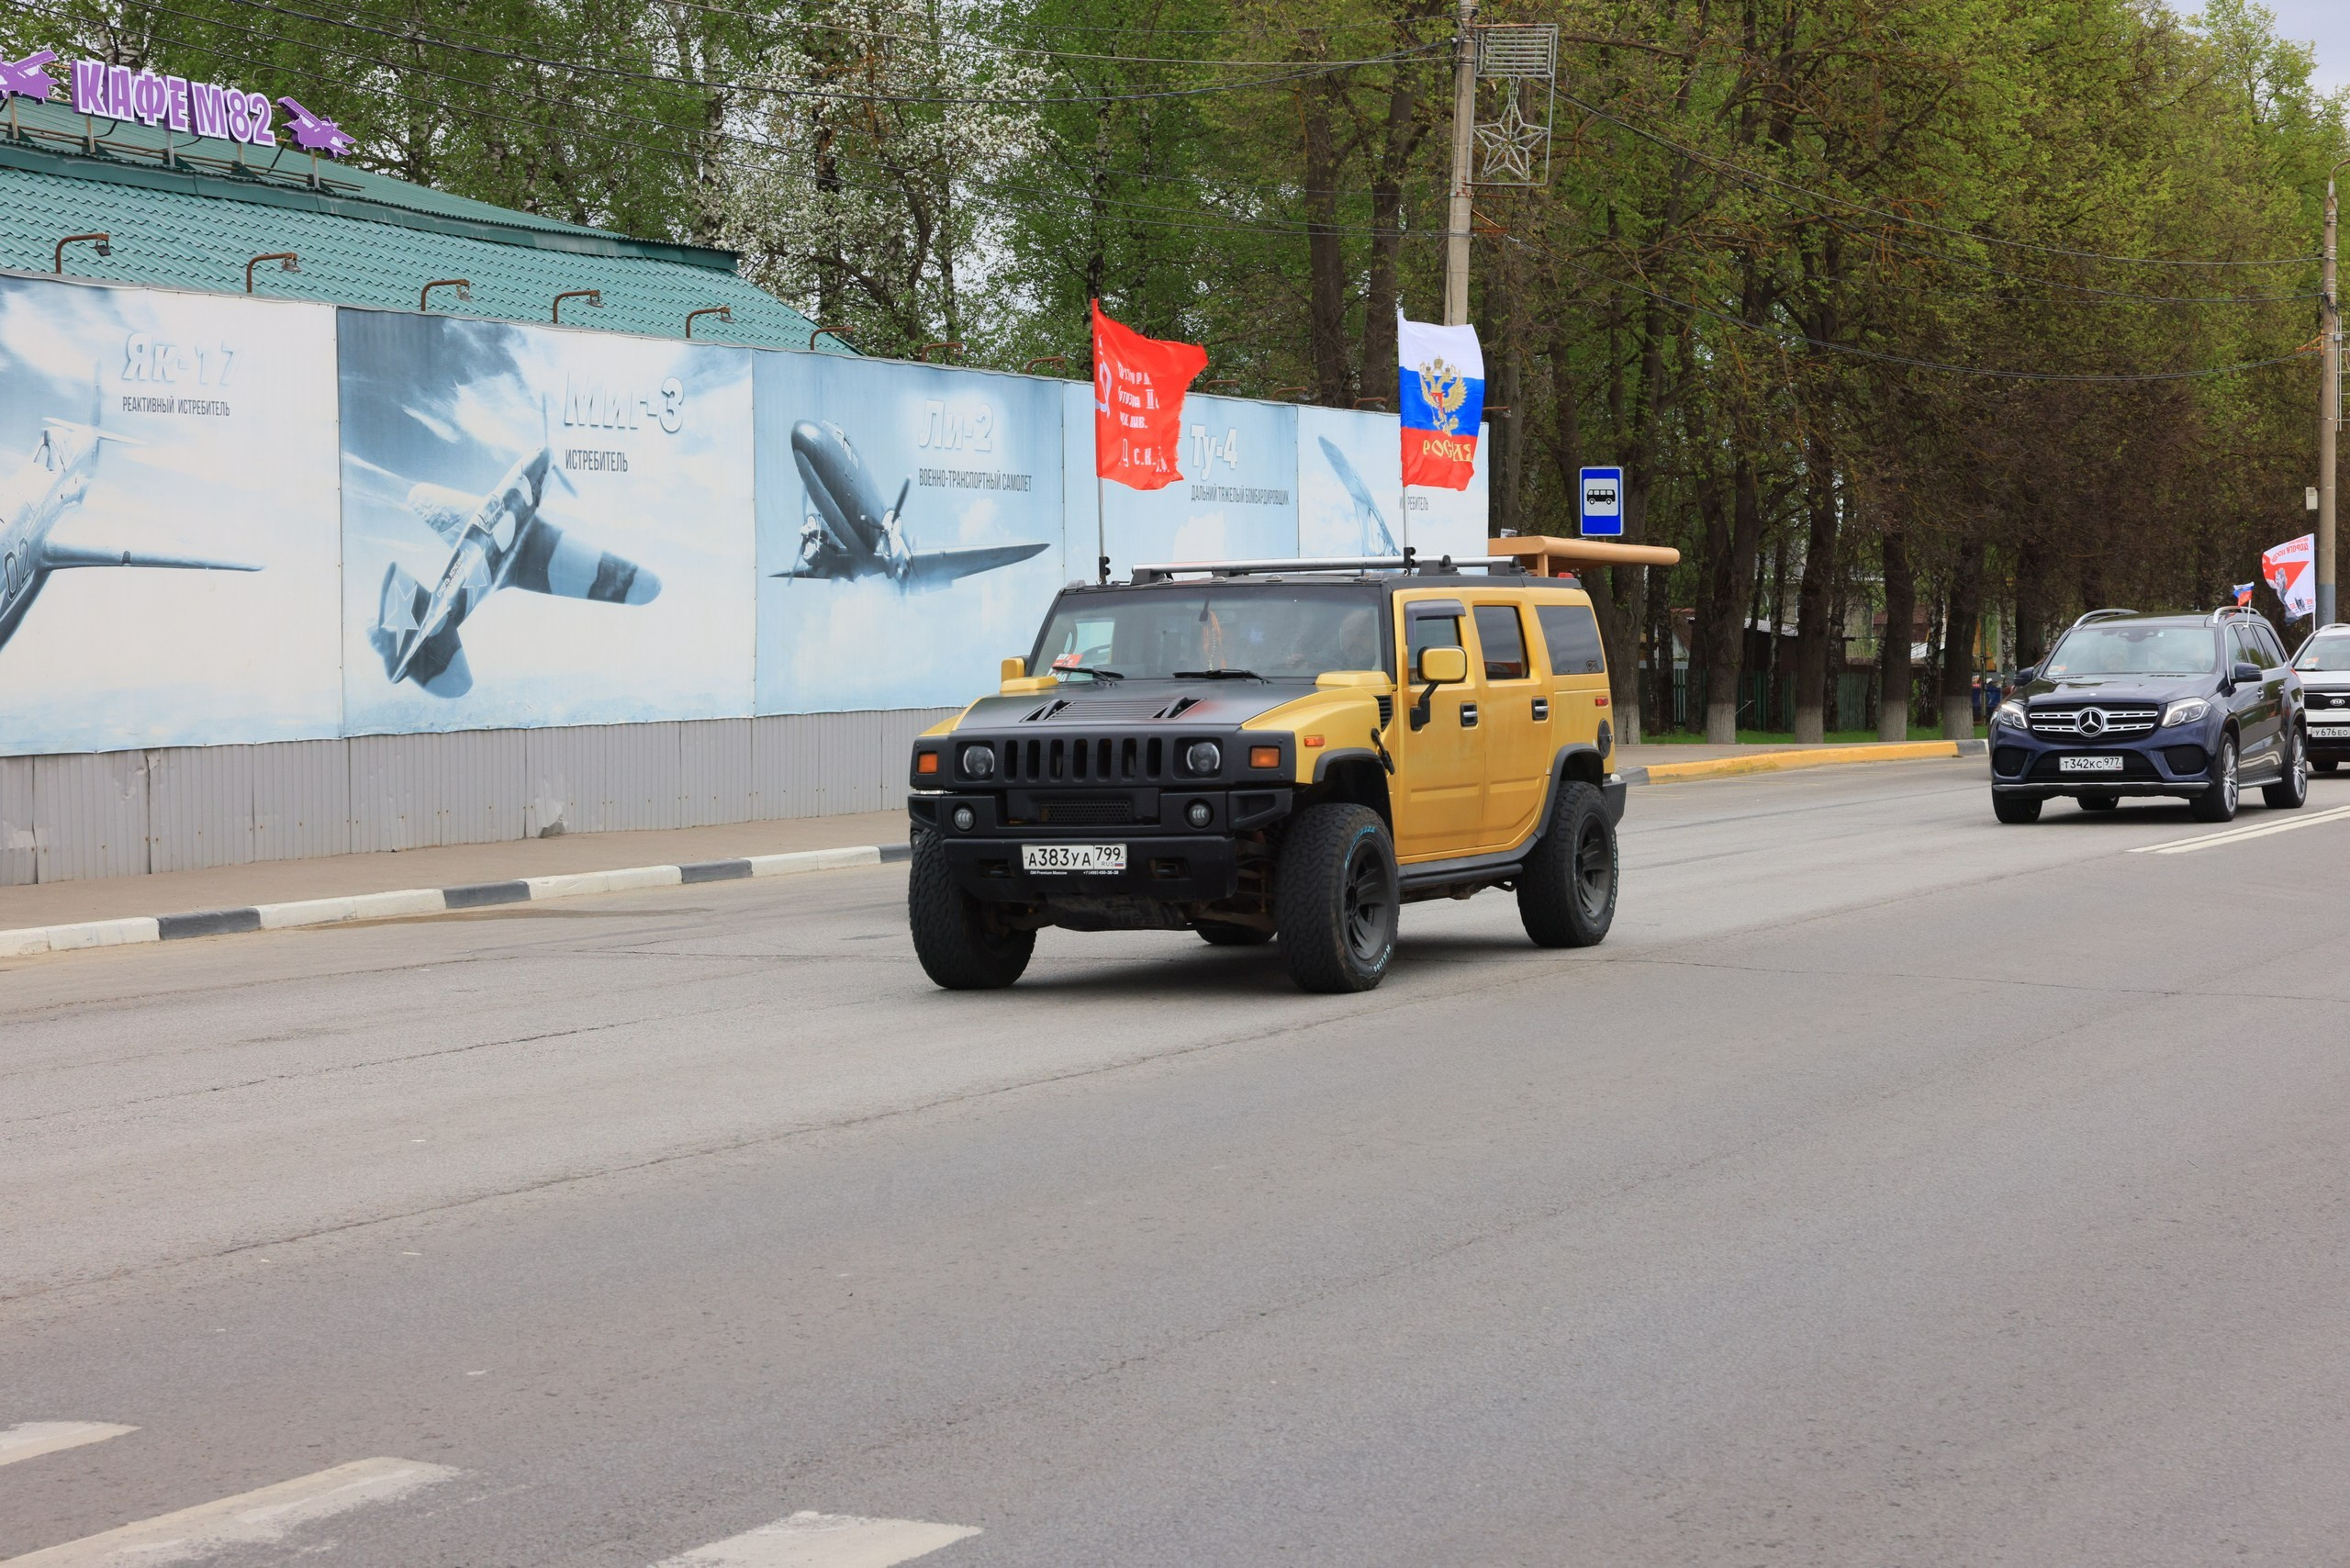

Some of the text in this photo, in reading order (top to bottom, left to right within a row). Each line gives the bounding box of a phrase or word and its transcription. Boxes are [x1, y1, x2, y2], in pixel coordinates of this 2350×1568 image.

[72, 59, 275, 147] КАФЕ М82
[121, 331, 242, 386] Як-17
[122, 395, 230, 416] РЕАКТИВНЫЙ ИСТРЕБИТЕЛЬ
[918, 399, 993, 453] Ли-2
[565, 449, 628, 472] ИСТРЕБИТЕЛЬ
[1191, 424, 1237, 481] Ту-4
[919, 468, 1032, 492] ВОЕННО-ТРАНСПОРТНЫЙ САМОЛЕТ
[1192, 484, 1217, 502] ДАЛЬНИЙ
[1399, 497, 1428, 510] ИРЕБИТЕЛЬ
[2064, 757, 2120, 769] Т342КС 977
[1028, 847, 1121, 867] А383УА 799
